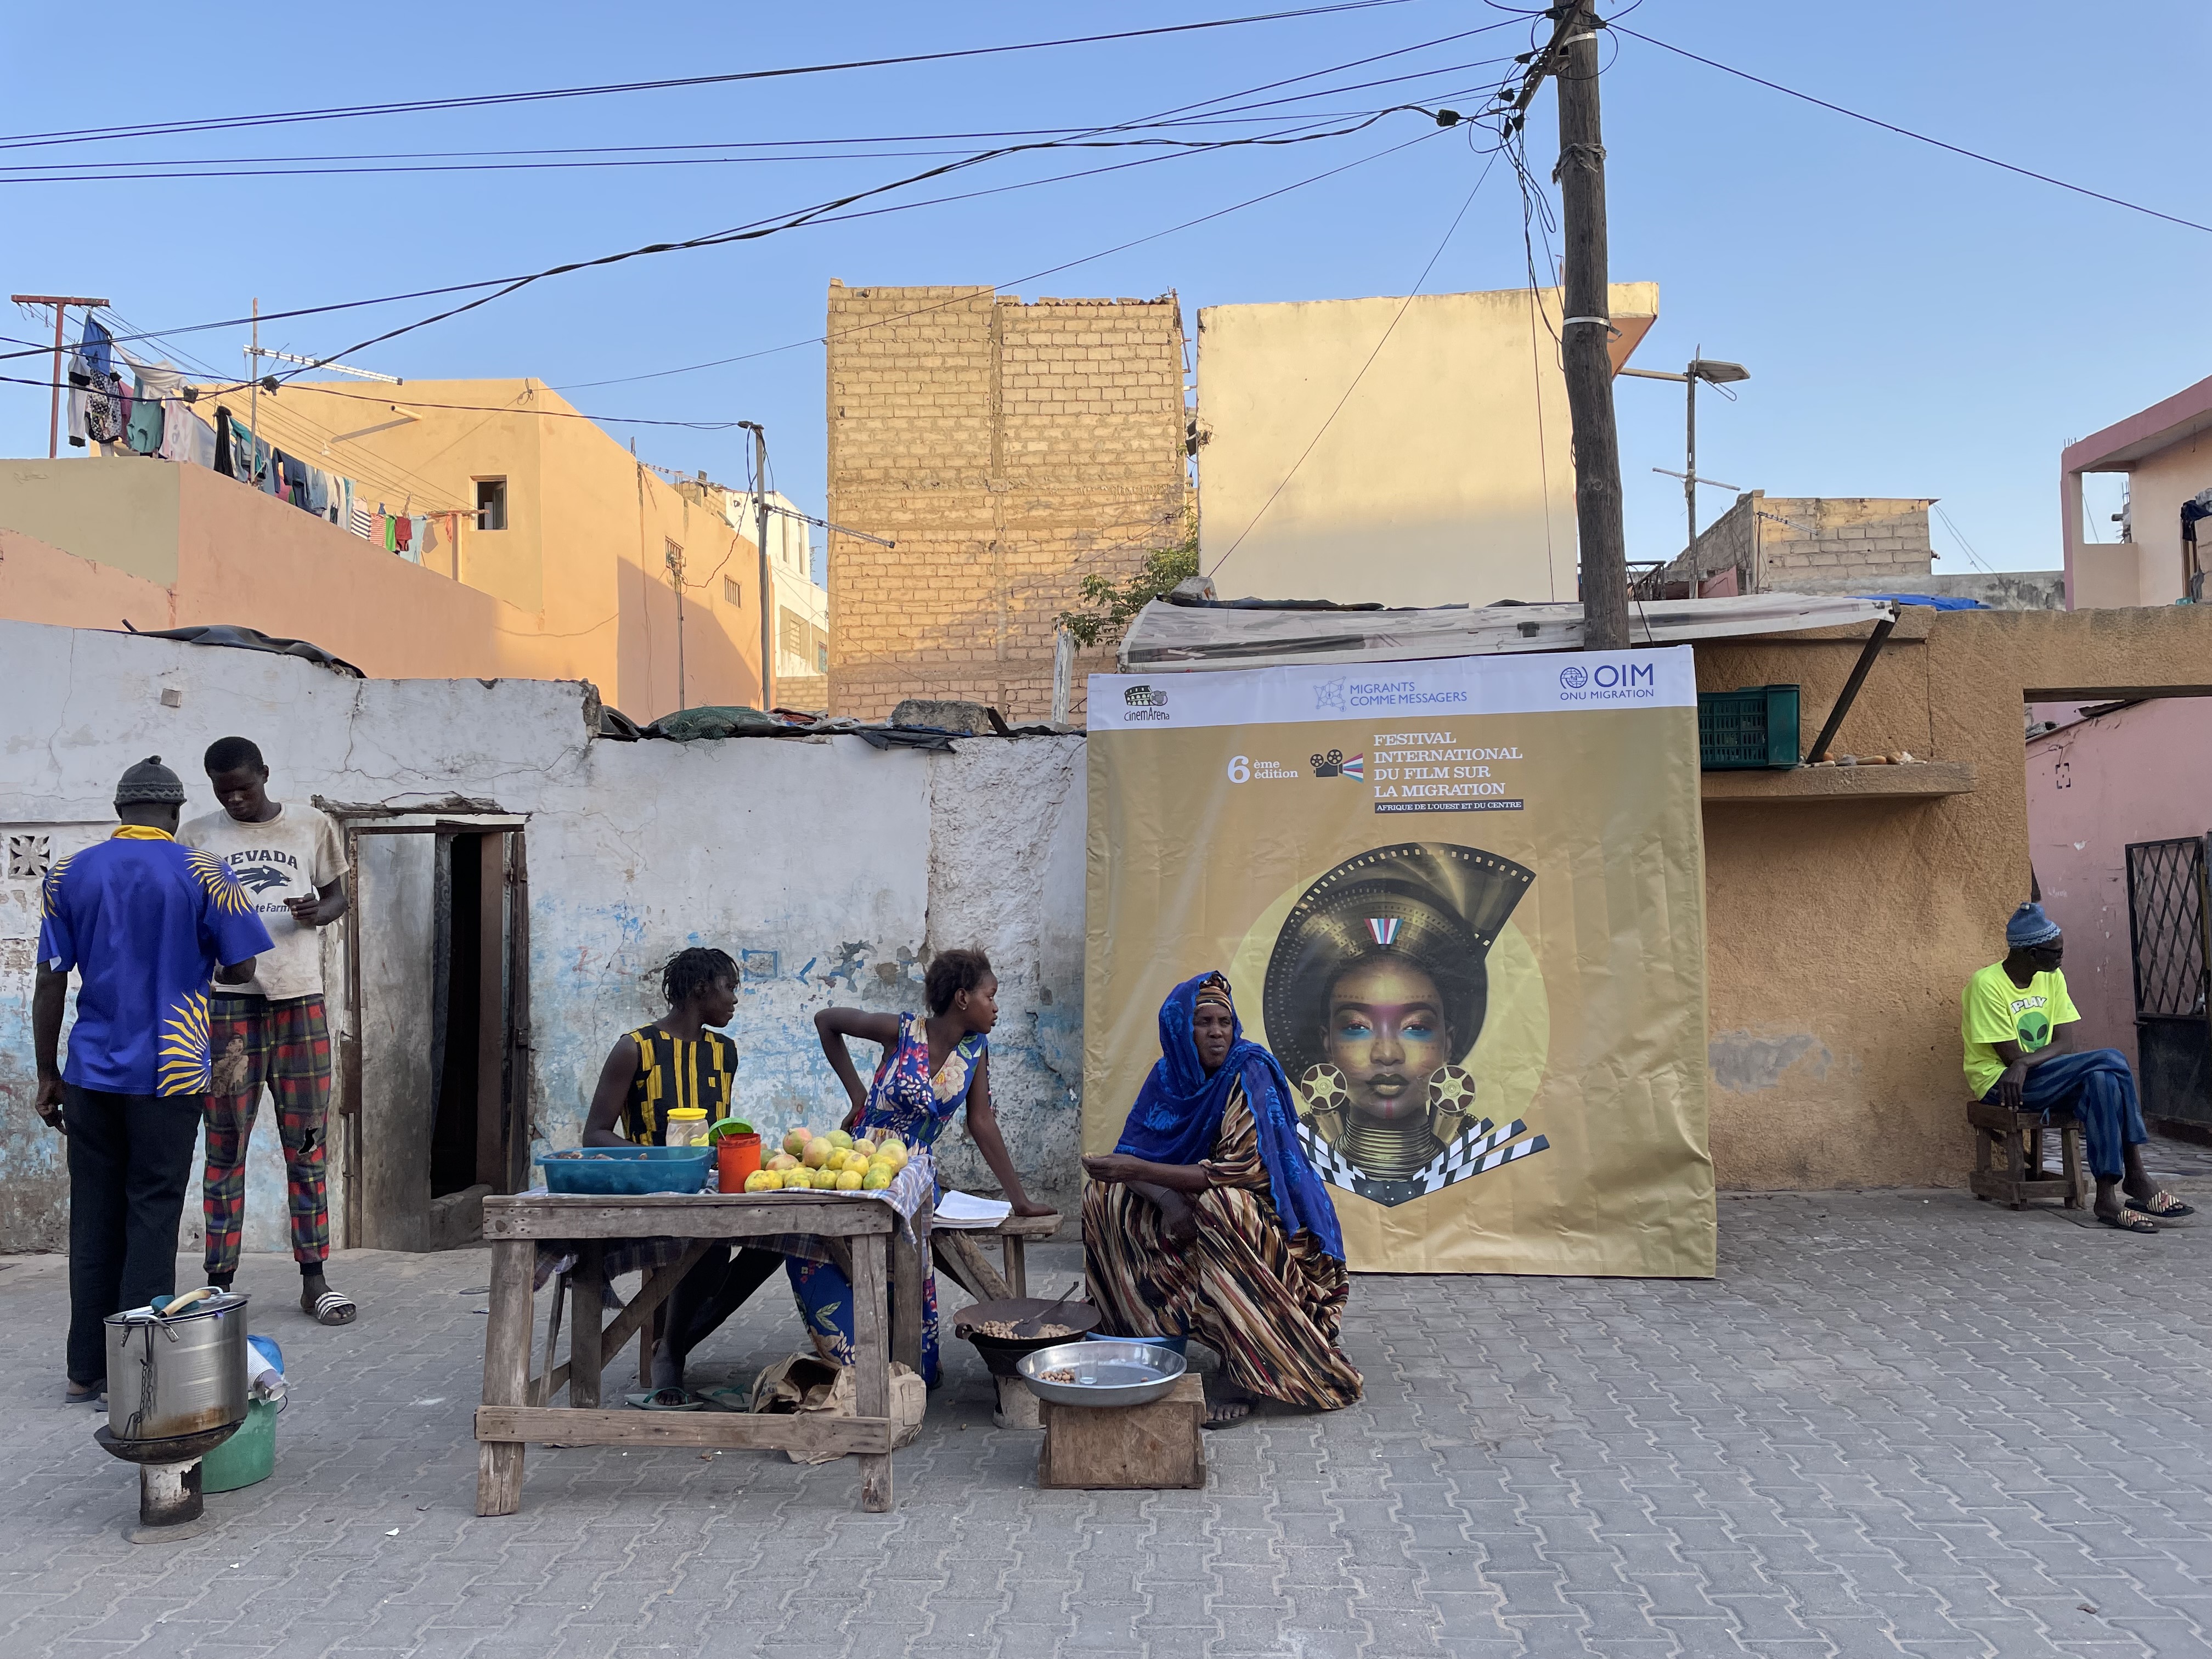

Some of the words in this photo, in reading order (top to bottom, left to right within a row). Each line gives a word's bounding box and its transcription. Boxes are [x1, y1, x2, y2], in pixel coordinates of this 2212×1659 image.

[1594, 663, 1654, 687] OIM
[1350, 682, 1415, 694] MIGRANTS
[1560, 692, 1586, 700] ONU
[1591, 689, 1654, 699] MIGRATION
[1351, 695, 1396, 706] COMME
[1399, 692, 1467, 704] MESSAGERS
[1374, 732, 1457, 746] FESTIVAL
[1374, 747, 1523, 764] INTERNATIONAL
[1227, 755, 1250, 783] 6
[1254, 759, 1280, 769] ème
[1254, 769, 1299, 779] édition
[1374, 768, 1400, 781] DU
[1404, 767, 1450, 780] FILM
[1454, 766, 1491, 778] SUR
[1374, 785, 1398, 798] LA
[1402, 783, 1505, 797] MIGRATION
[224, 850, 298, 870] EVADA
